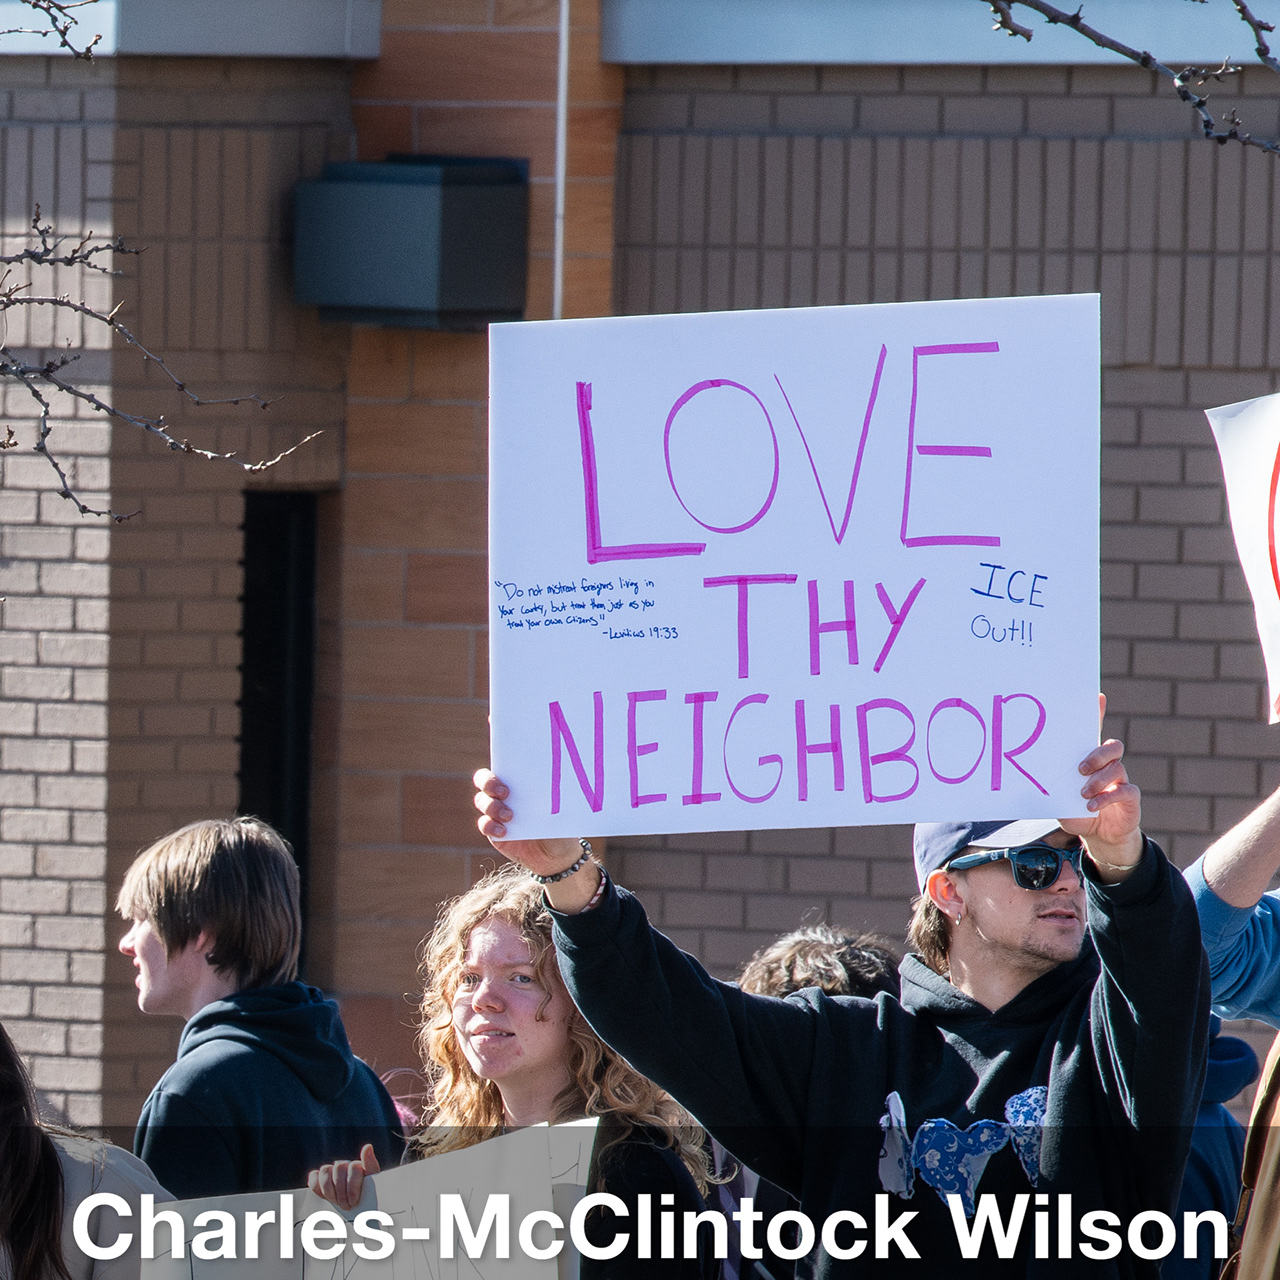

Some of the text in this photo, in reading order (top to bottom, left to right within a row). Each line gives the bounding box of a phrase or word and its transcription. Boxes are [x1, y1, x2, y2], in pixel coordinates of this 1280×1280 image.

[576, 341, 1000, 563] LOVE
[528, 584, 544, 597] not
[619, 577, 639, 595] living
[644, 580, 655, 588] in
[970, 562, 1048, 608] ICE
[550, 600, 568, 612] but
[607, 599, 624, 613] just
[629, 600, 639, 610] as
[544, 619, 563, 627] own
[649, 626, 679, 640] 19:33
[703, 573, 927, 679] THY
[970, 614, 1033, 647] Out!!
[549, 690, 1050, 814] NEIGHBOR
